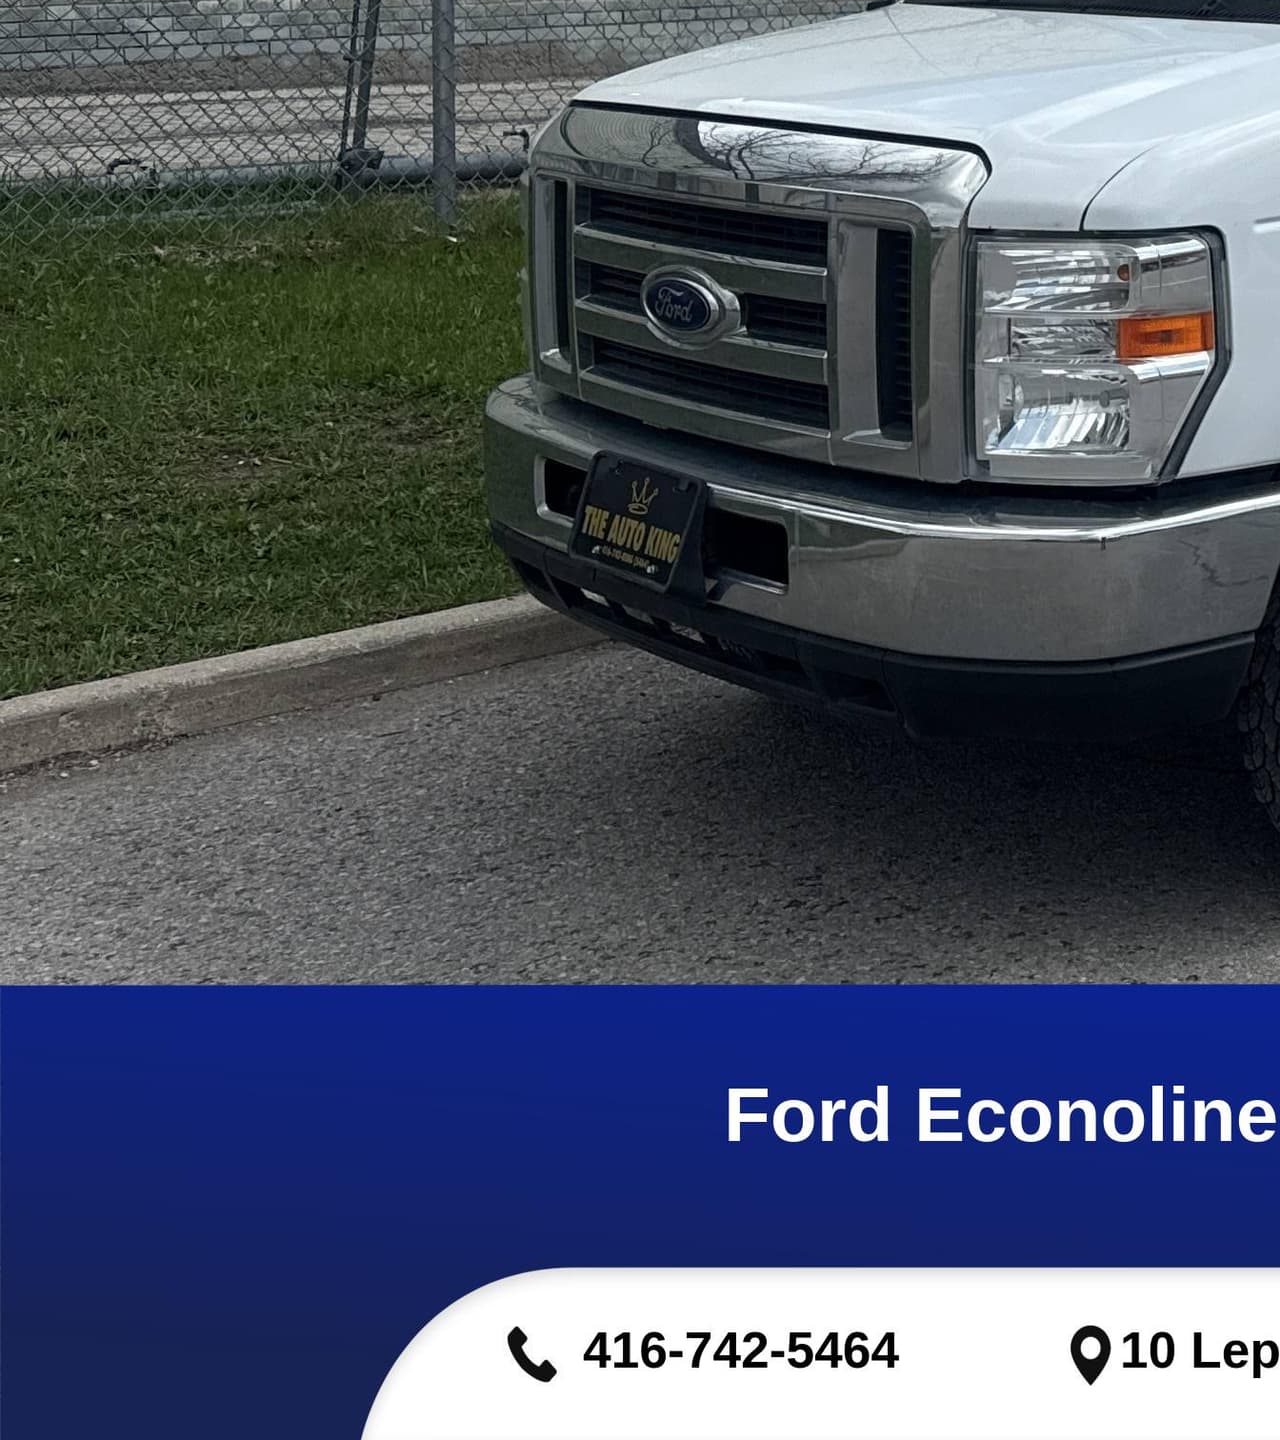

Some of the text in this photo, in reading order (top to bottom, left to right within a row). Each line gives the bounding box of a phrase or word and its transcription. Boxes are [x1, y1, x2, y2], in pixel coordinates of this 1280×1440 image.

[655, 286, 694, 323] Ford
[582, 505, 609, 539] THE
[606, 514, 646, 551] AUTO
[644, 525, 681, 563] KING
